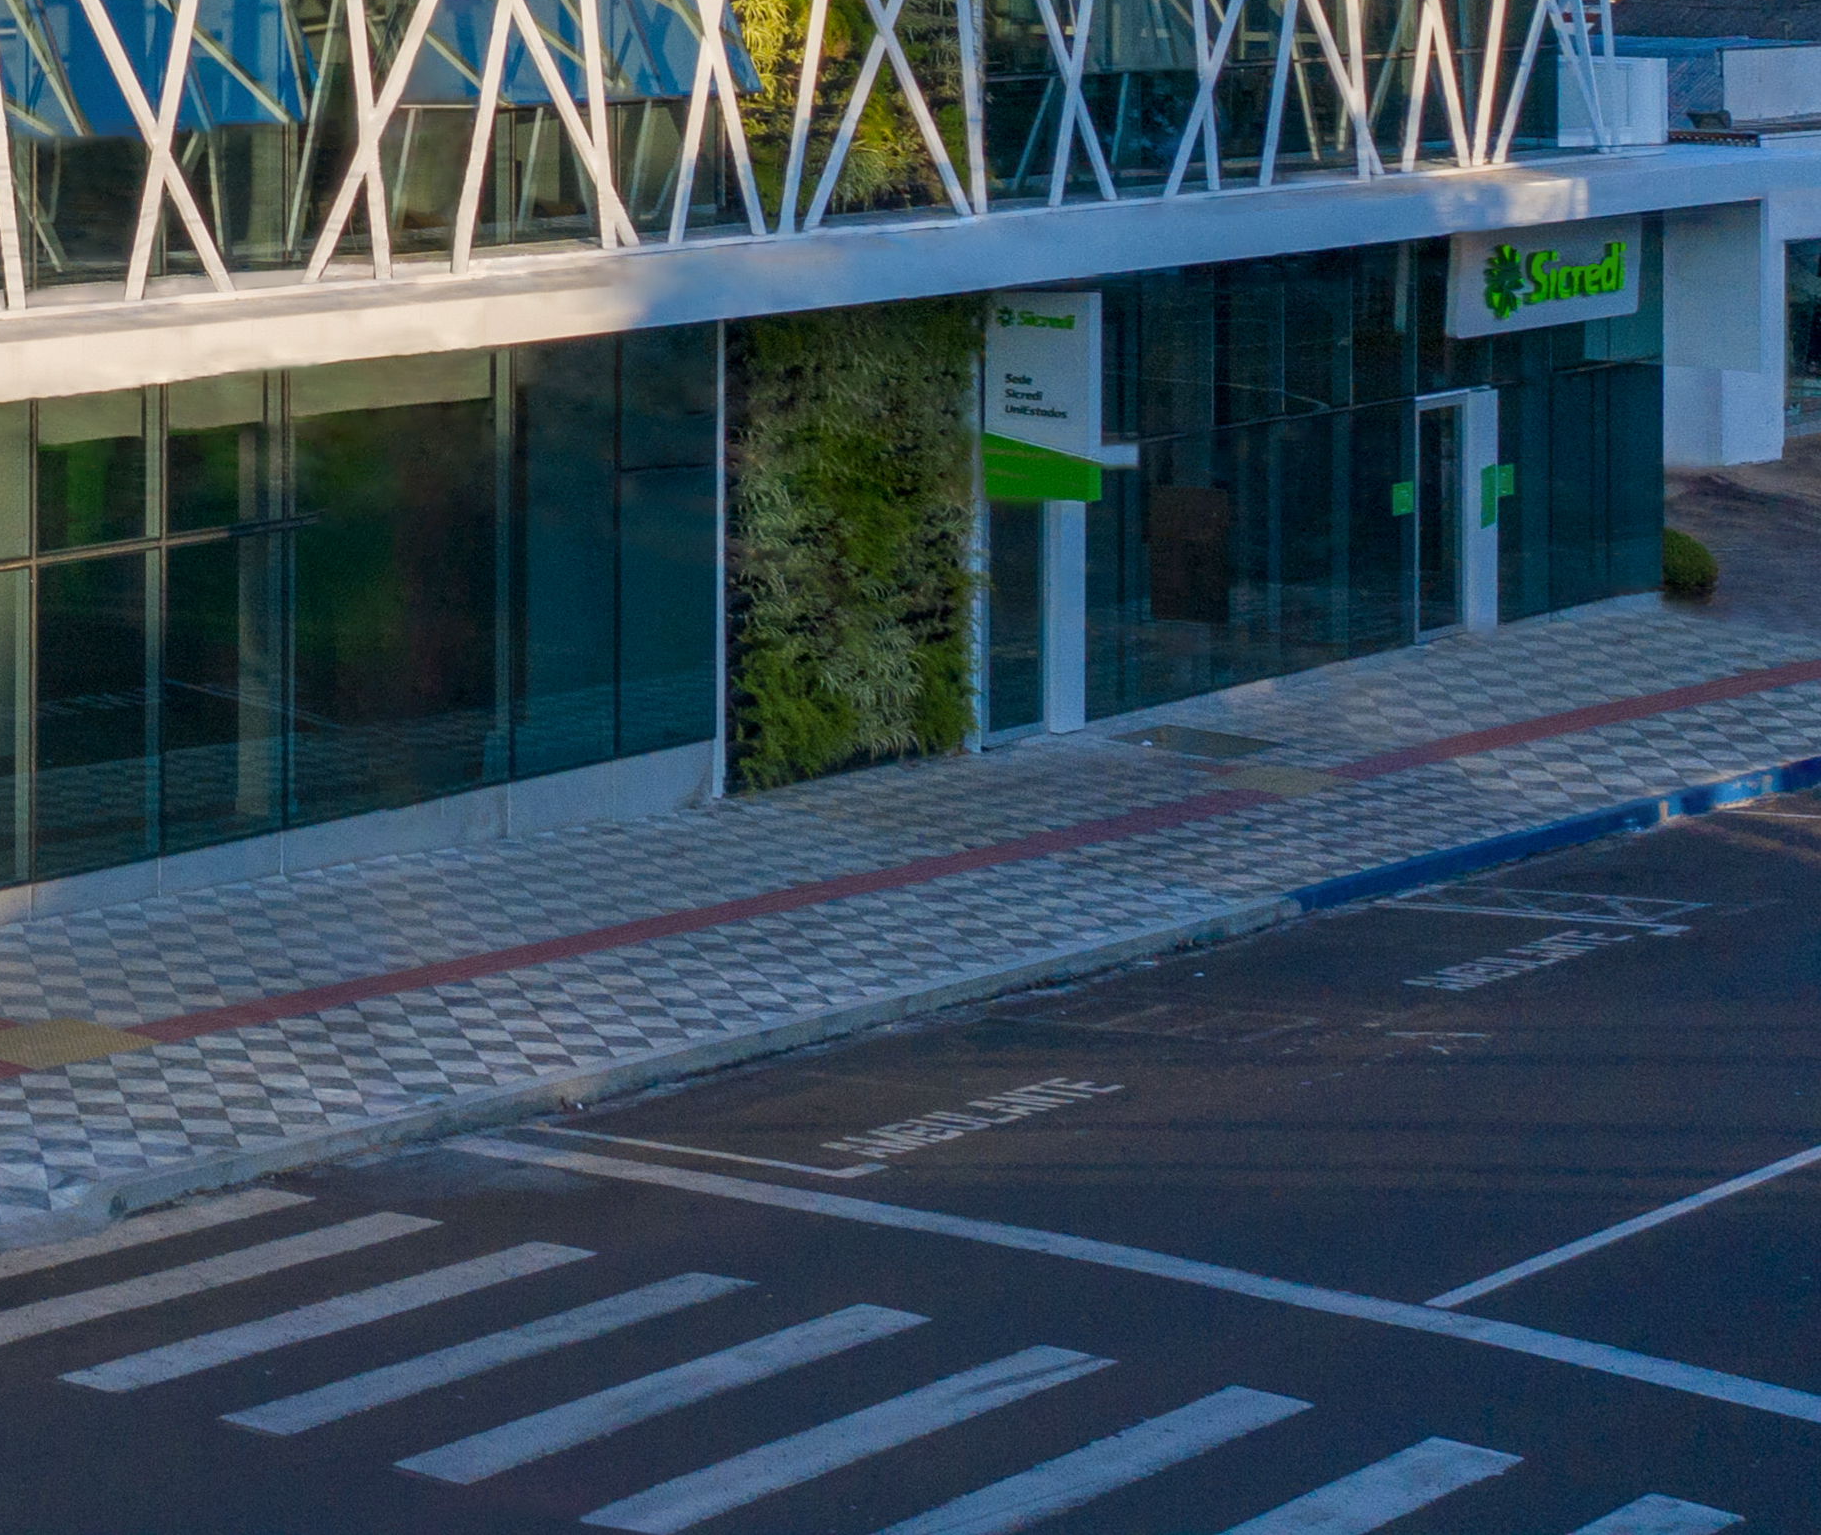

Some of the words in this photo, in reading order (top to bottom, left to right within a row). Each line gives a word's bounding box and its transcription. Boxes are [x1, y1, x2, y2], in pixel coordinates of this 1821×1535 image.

[1524, 242, 1626, 303] Sicredi
[1018, 310, 1076, 331] Sicredi
[1005, 373, 1032, 385] Sede
[1004, 388, 1043, 401] Sicredi
[1005, 404, 1068, 419] UniEstados
